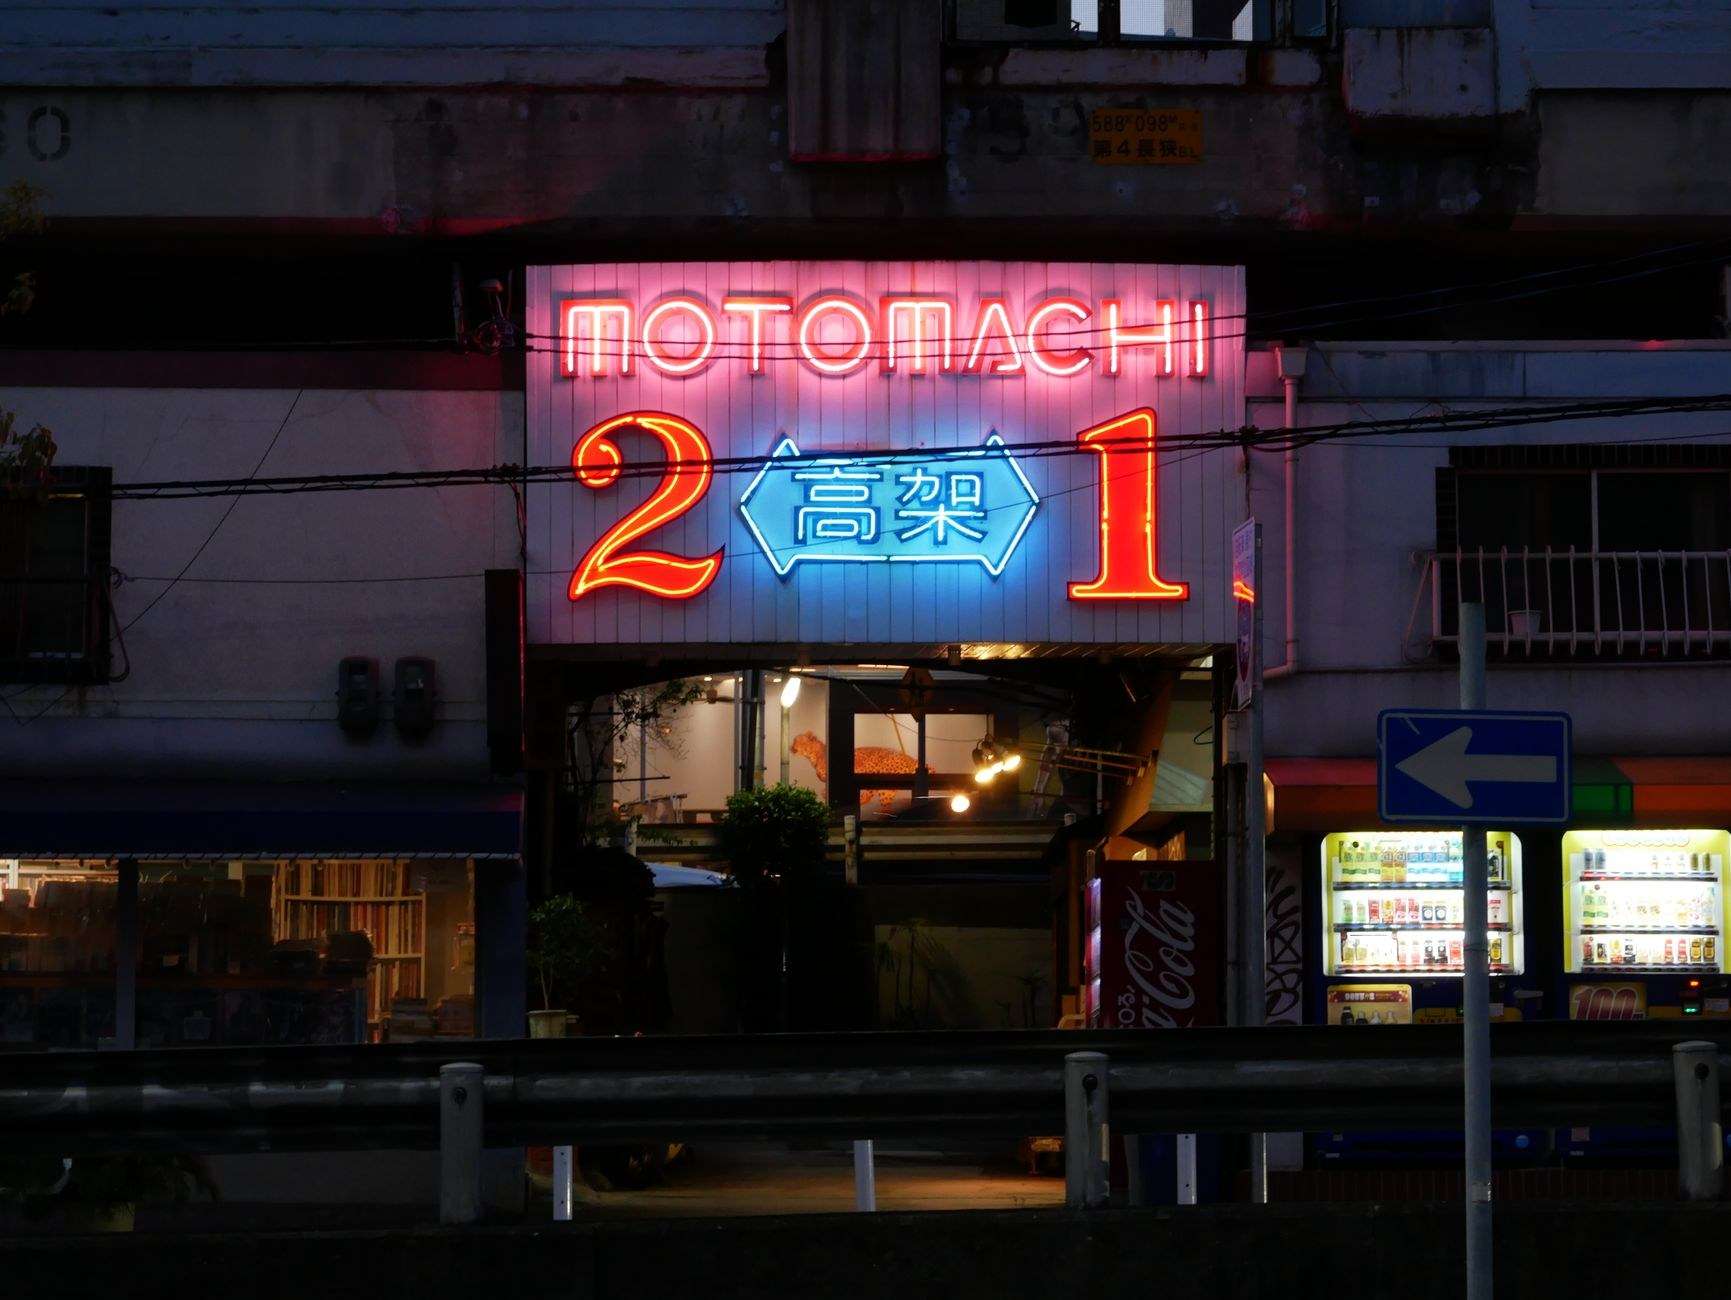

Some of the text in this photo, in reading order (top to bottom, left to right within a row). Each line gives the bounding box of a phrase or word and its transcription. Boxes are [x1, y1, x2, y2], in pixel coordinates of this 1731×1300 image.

[560, 295, 1208, 378] MOTOMACHI
[568, 407, 1190, 601] 2 高架 1
